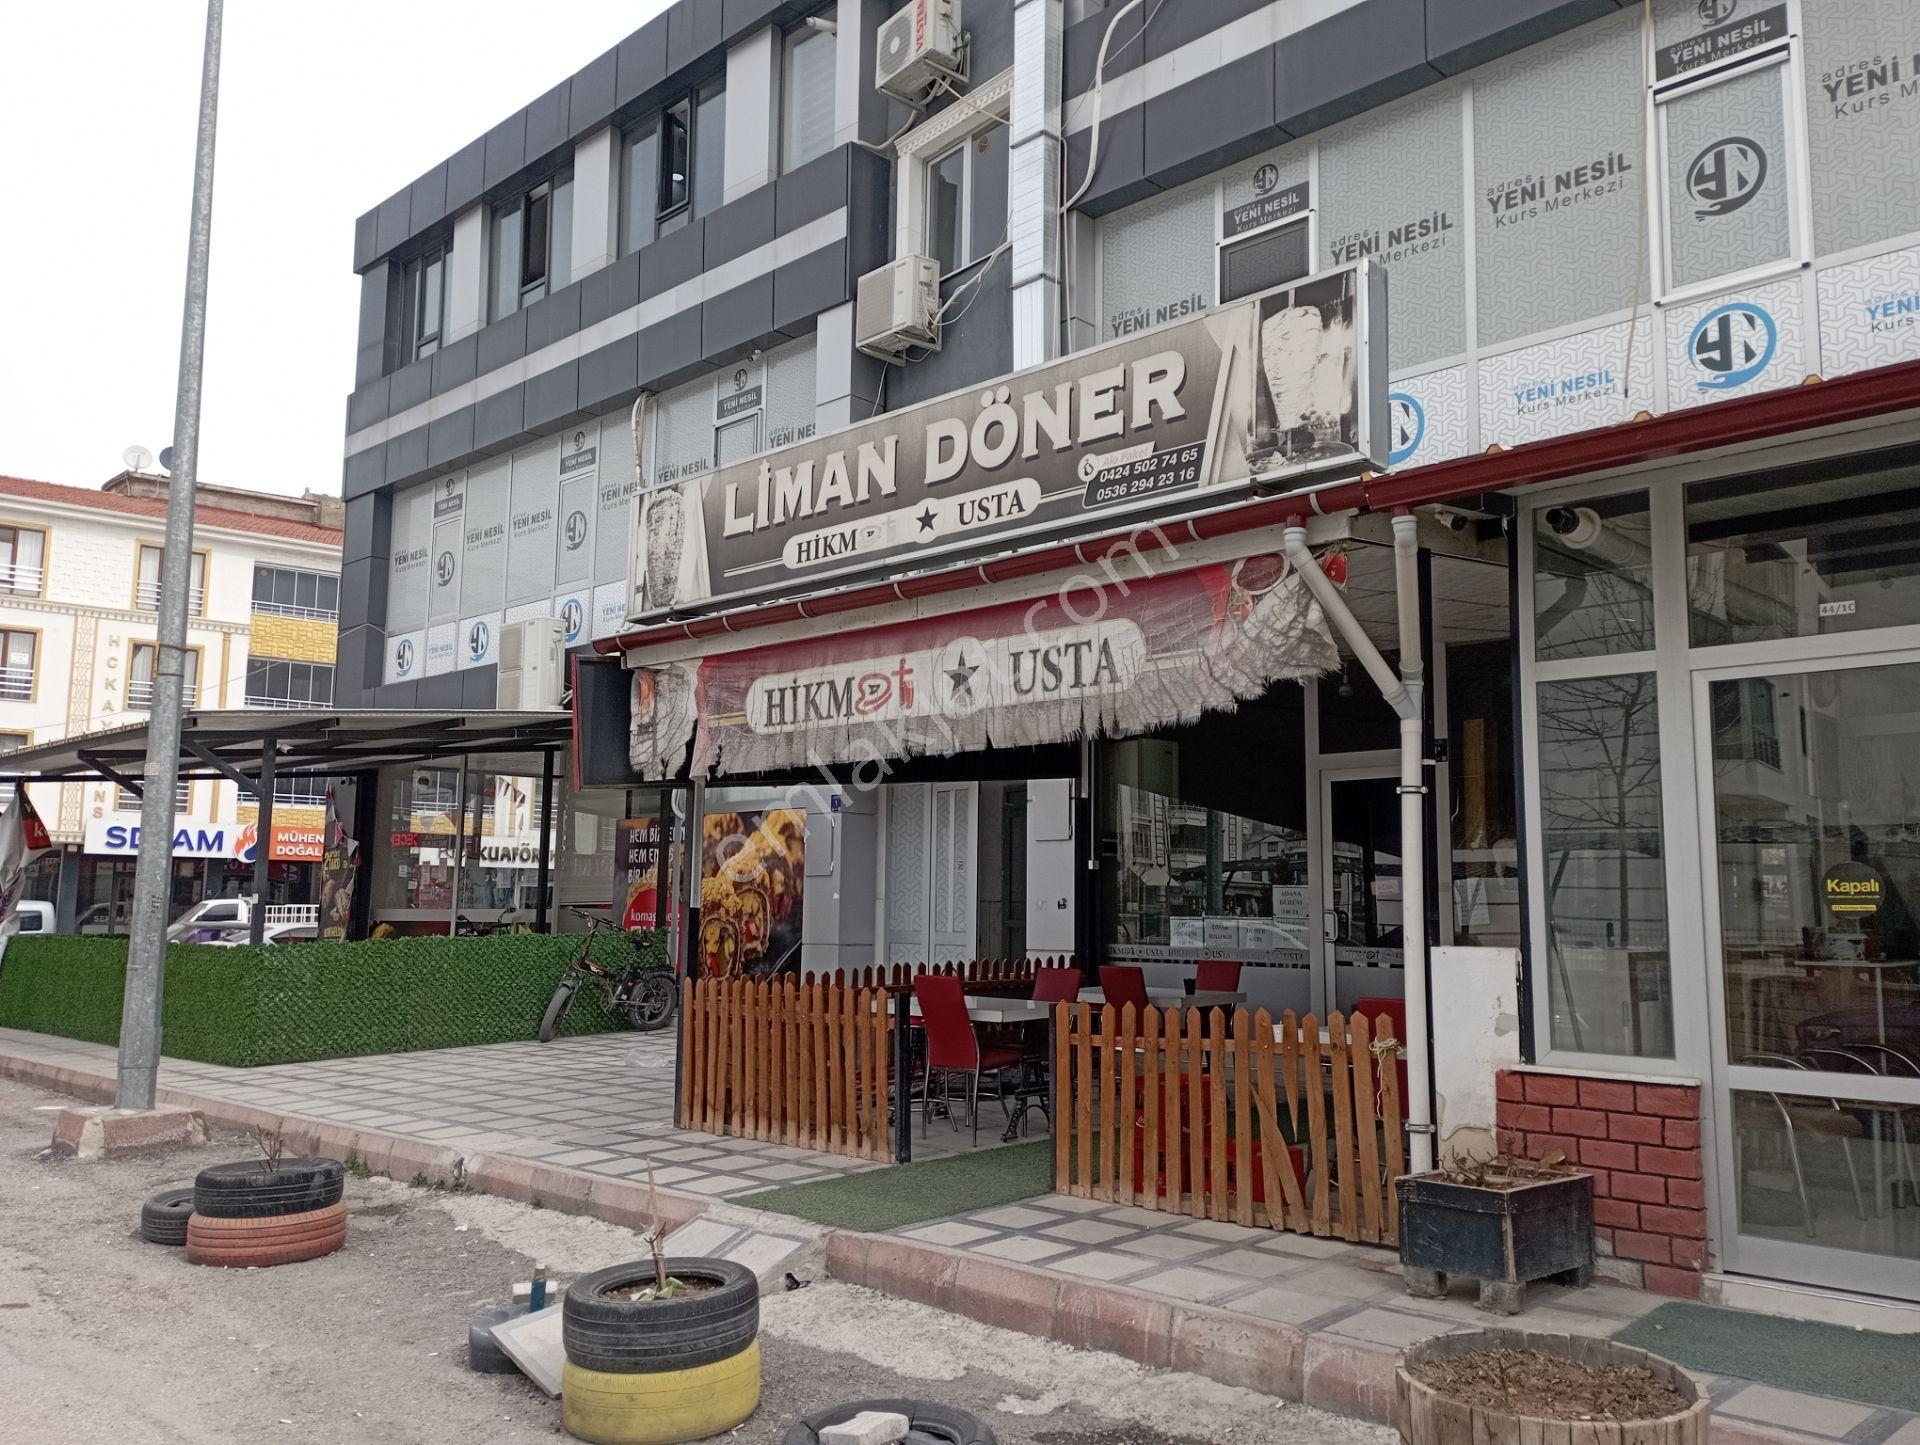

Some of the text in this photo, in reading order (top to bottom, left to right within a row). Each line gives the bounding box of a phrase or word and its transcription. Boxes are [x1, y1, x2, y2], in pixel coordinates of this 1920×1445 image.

[1670, 20, 1771, 64] YENİ NESİL
[1676, 36, 1766, 74] Kurs Merkezi
[1822, 56, 1882, 82] adres
[1823, 56, 1900, 102] YENİ
[1835, 93, 1890, 119] Kurs
[1487, 174, 1533, 196] adres
[1488, 152, 1632, 214] YENİ NESİL
[1234, 193, 1300, 224] YENİ NESİL
[1496, 176, 1623, 229] Kurs Merkezi
[1237, 221, 1257, 232] Kurs
[1330, 230, 1369, 249] adres
[1331, 211, 1453, 265] YENİ NESİL
[1380, 233, 1446, 265] Merkezi
[1112, 307, 1142, 322] adres
[1112, 293, 1207, 338] YENİ NESİL
[1872, 317, 1914, 333] Kurs
[1517, 383, 1616, 416] Kurs Merkezi
[723, 350, 1187, 538] LİMAN DÖNER
[770, 427, 794, 448] YENİ
[658, 457, 709, 483] YENİ NESİL
[1100, 447, 1198, 483] 0424 502 74 65
[601, 484, 621, 502] YENİ
[1097, 467, 1195, 501] 0536 294 23 16
[513, 507, 552, 530] YENİ NESİL
[958, 489, 1026, 525] USTA
[1010, 637, 1121, 696] USTA
[630, 828, 647, 843] HEM
[276, 844, 323, 857] DOĞAL
[629, 848, 646, 864] HEM
[628, 866, 640, 884] BİR
[1827, 878, 1880, 895] Kapalı
